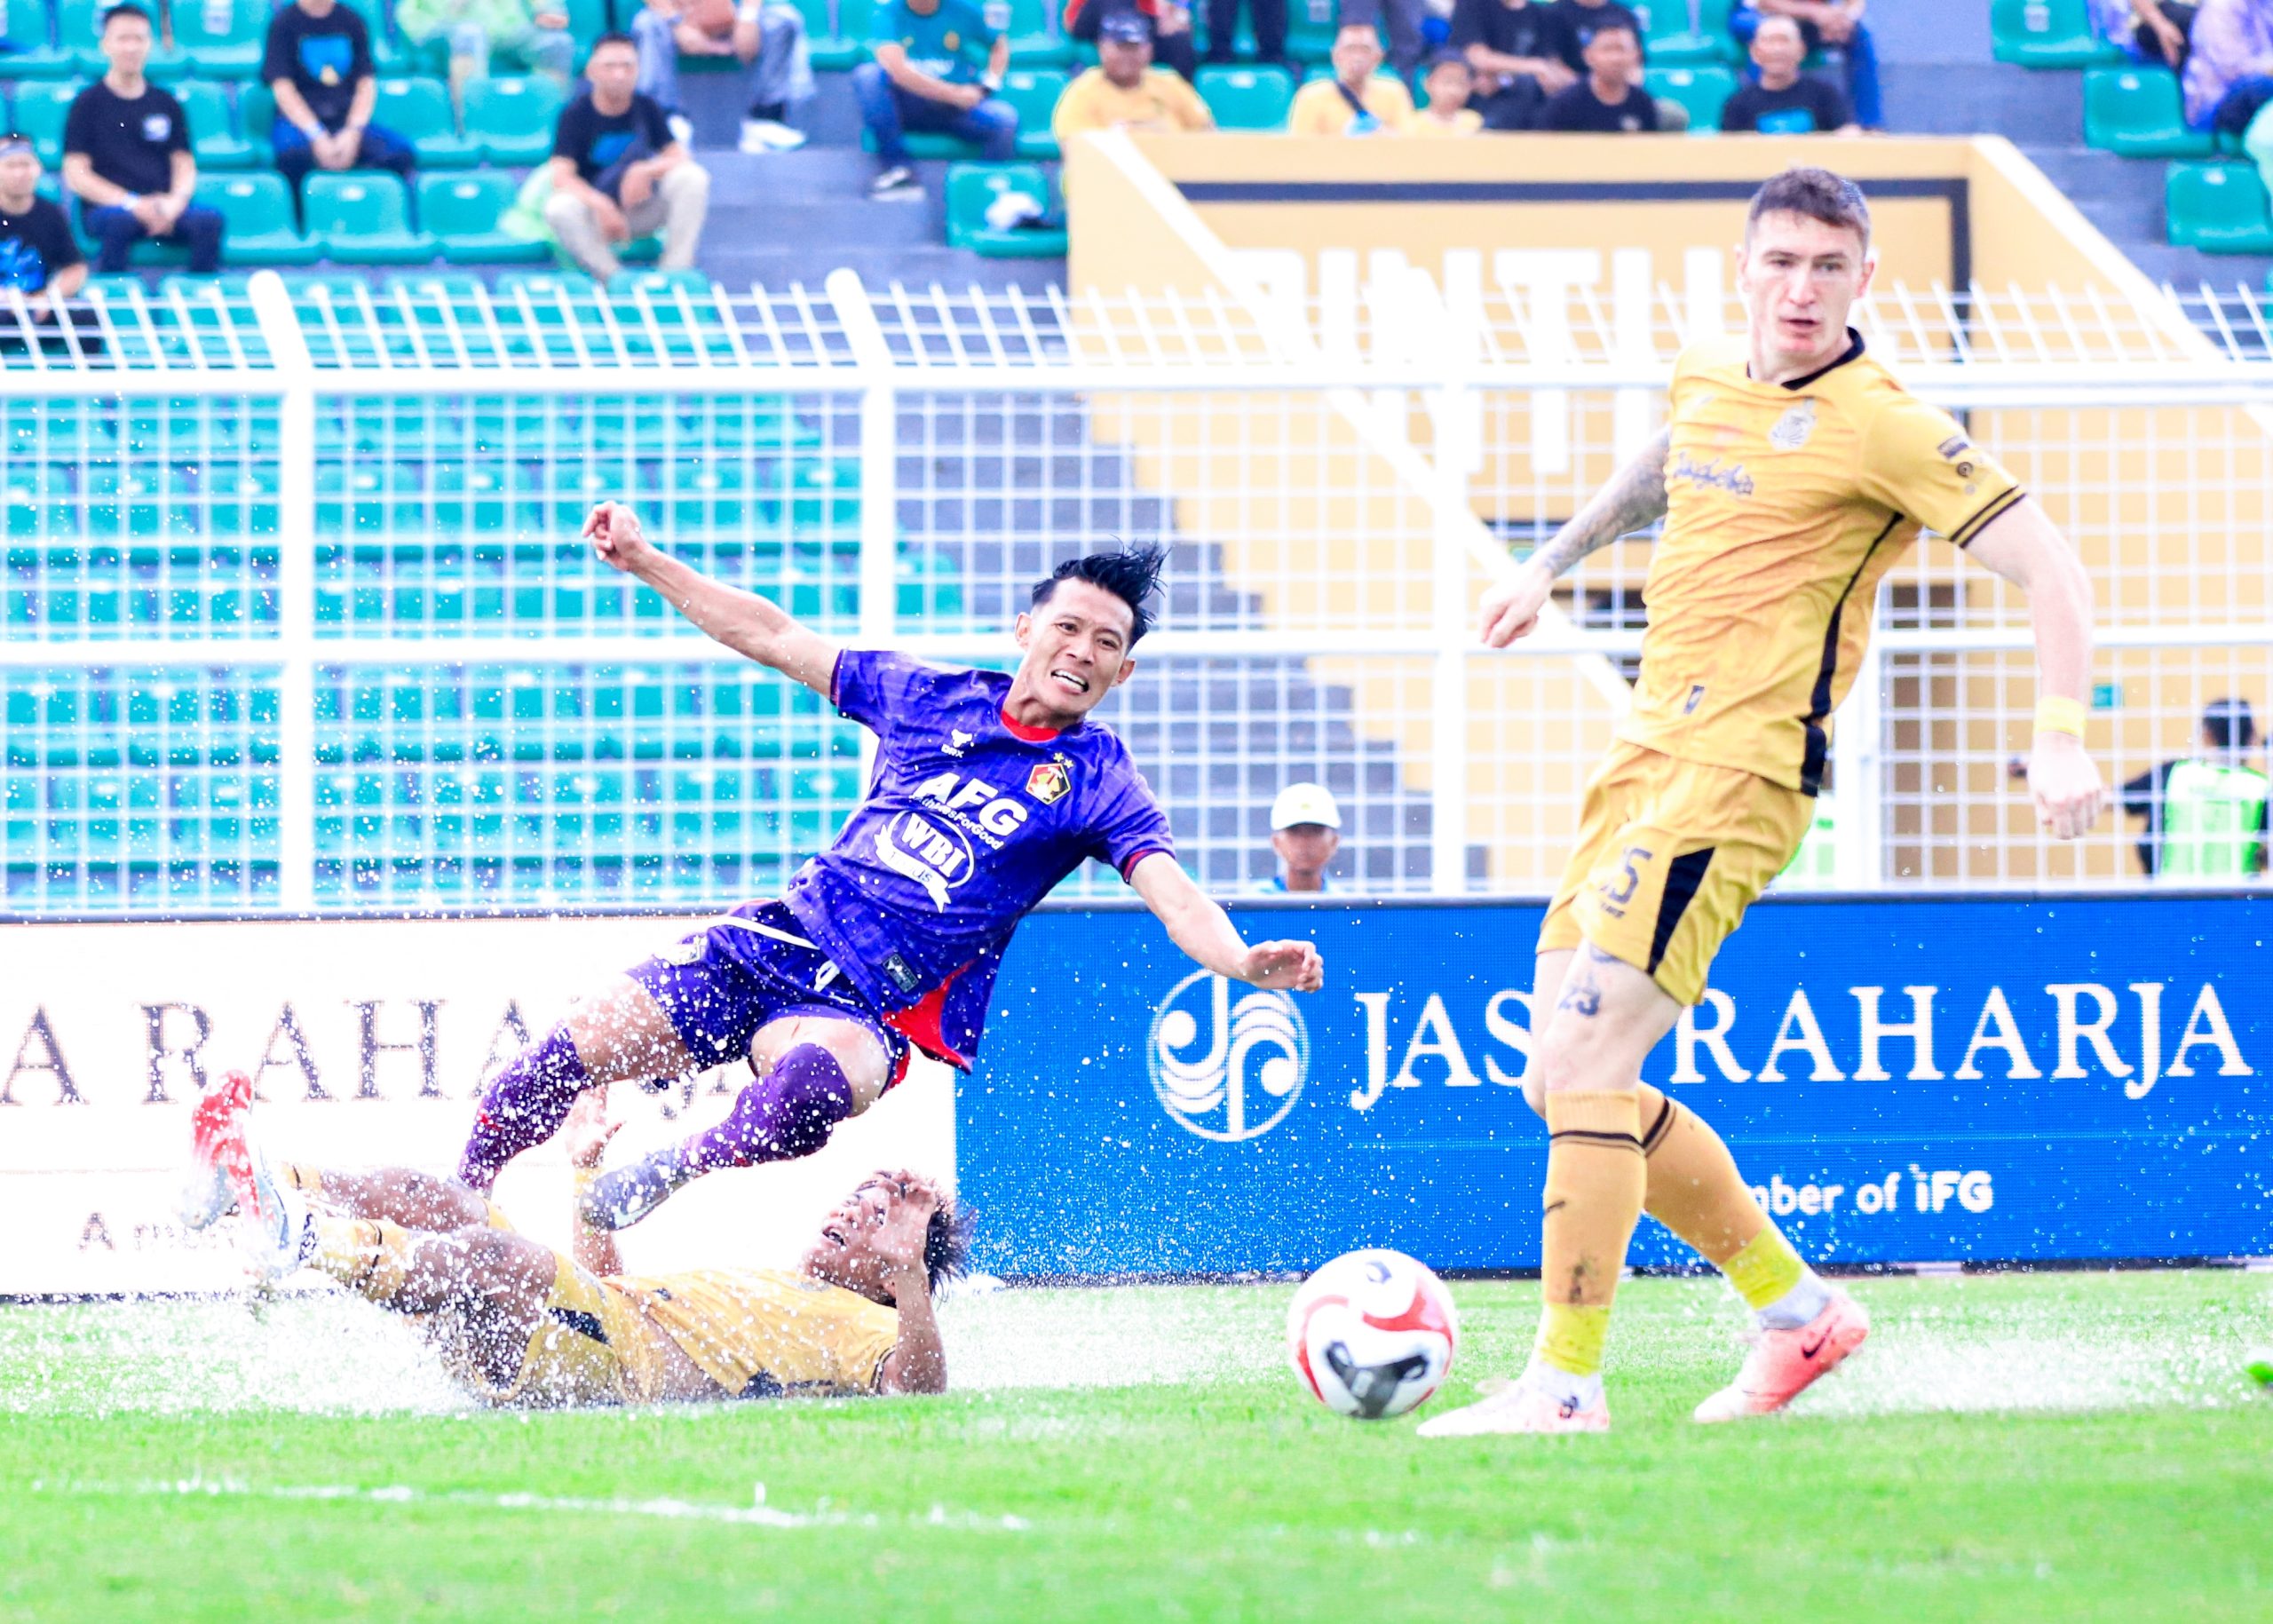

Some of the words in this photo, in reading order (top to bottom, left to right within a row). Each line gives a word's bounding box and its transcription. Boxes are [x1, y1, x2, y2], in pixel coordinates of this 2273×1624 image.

[911, 772, 1028, 836] AFG
[901, 812, 966, 877] WBI
[1350, 989, 1534, 1111] JAS
[1670, 982, 2253, 1099] RAHARJA
[1856, 1172, 1902, 1215] of
